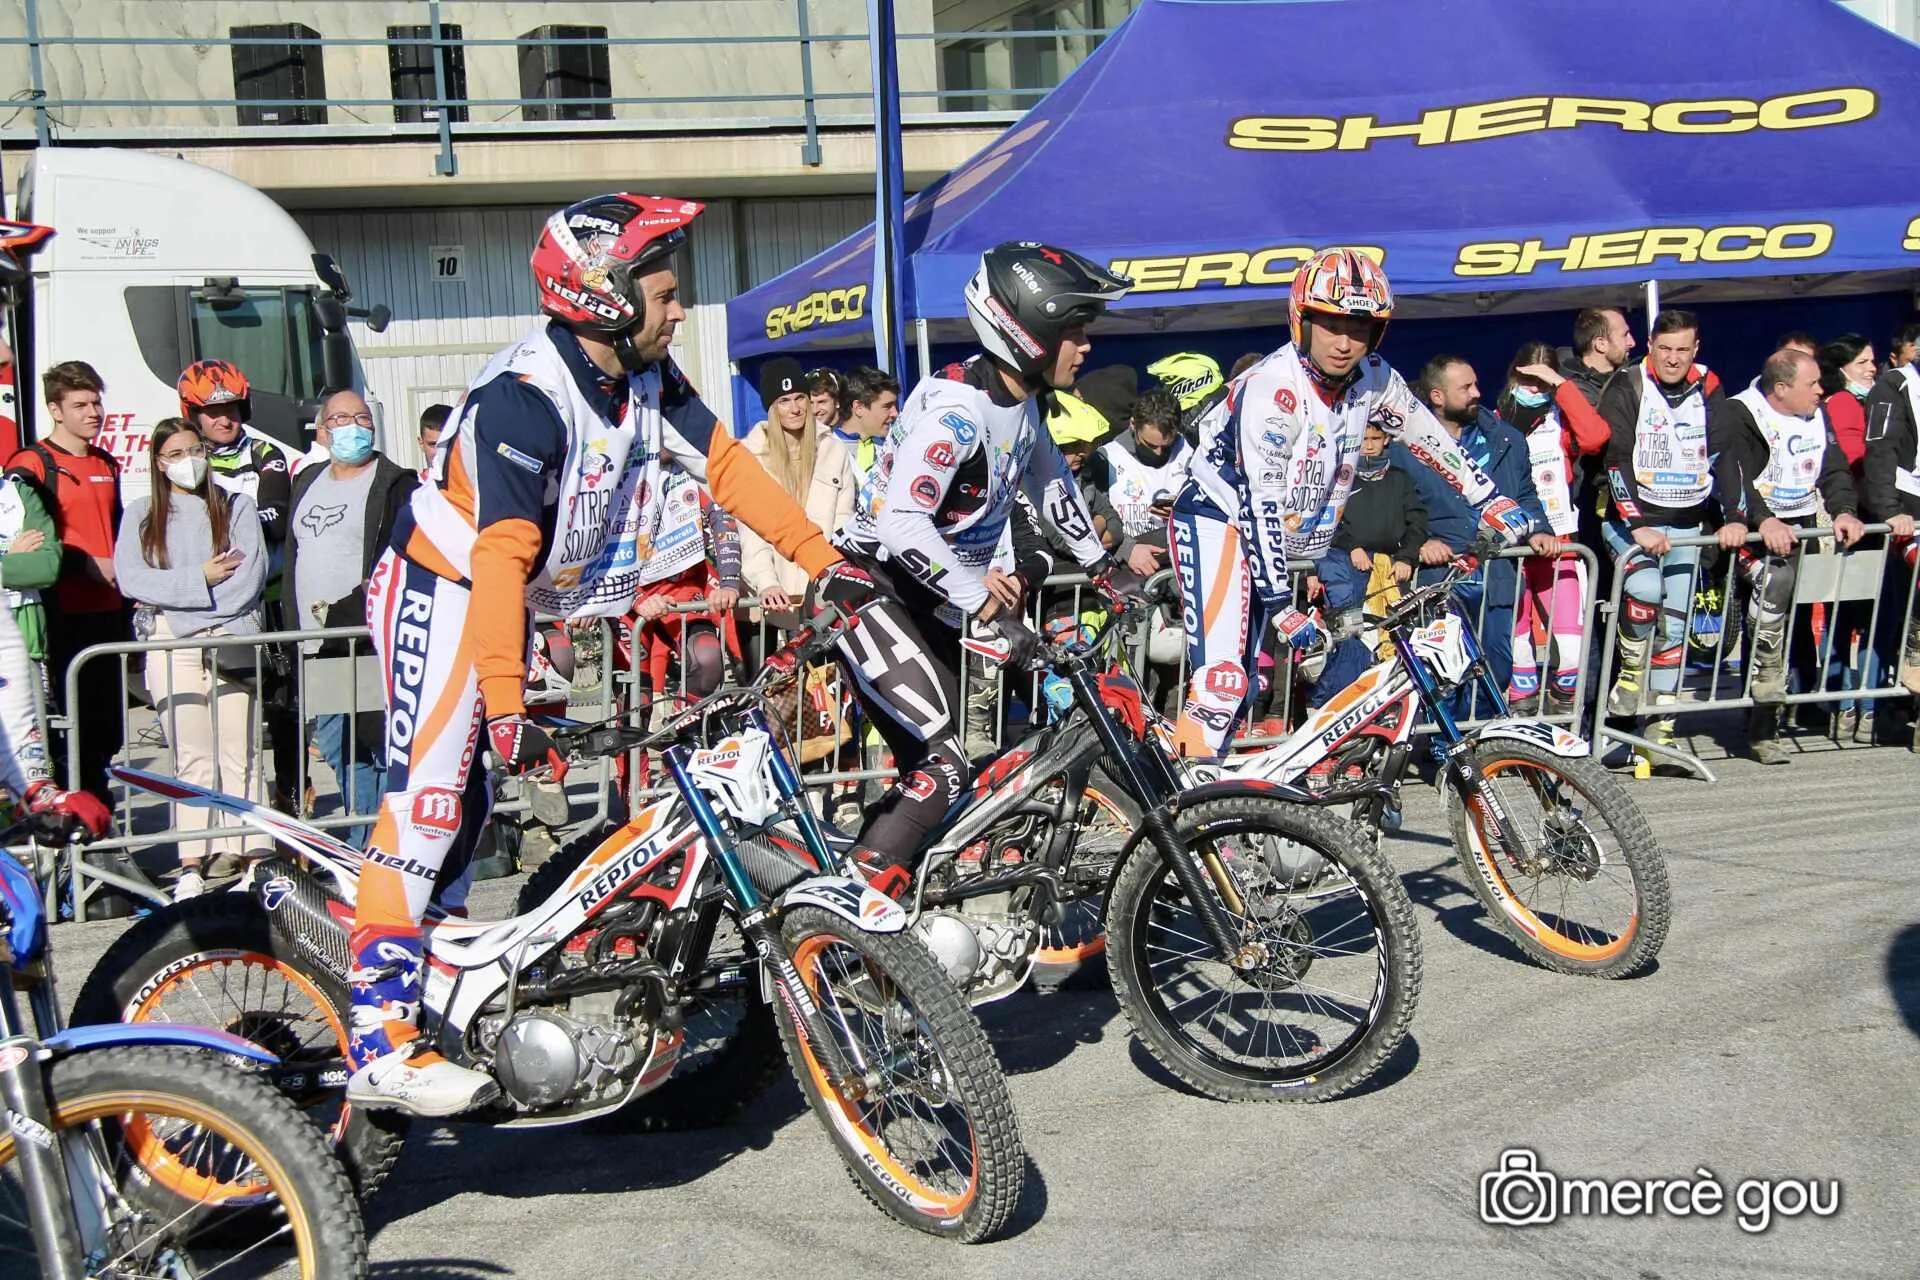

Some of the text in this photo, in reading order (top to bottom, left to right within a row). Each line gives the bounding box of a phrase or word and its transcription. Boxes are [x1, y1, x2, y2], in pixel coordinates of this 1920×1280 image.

[1228, 87, 1877, 151] SHERCO
[437, 257, 458, 276] 10
[1108, 245, 1386, 293] ERC
[1453, 222, 1835, 277] SHERCO
[765, 284, 868, 339] SHERCO
[1170, 370, 1214, 397] Airoh
[104, 413, 136, 432] ET
[125, 434, 152, 453] TH
[1260, 499, 1293, 586] REPSOL
[1171, 519, 1200, 649] REPSOL
[1417, 629, 1447, 641] REPSOL
[387, 586, 434, 768] REPSOL
[1322, 696, 1384, 748] REPSOL
[697, 750, 743, 767] REPSOL
[580, 838, 664, 911] REPSOL
[1473, 850, 1508, 902] REPSOL
[319, 1070, 348, 1082] NGK
[862, 1152, 914, 1203] REPSOL
